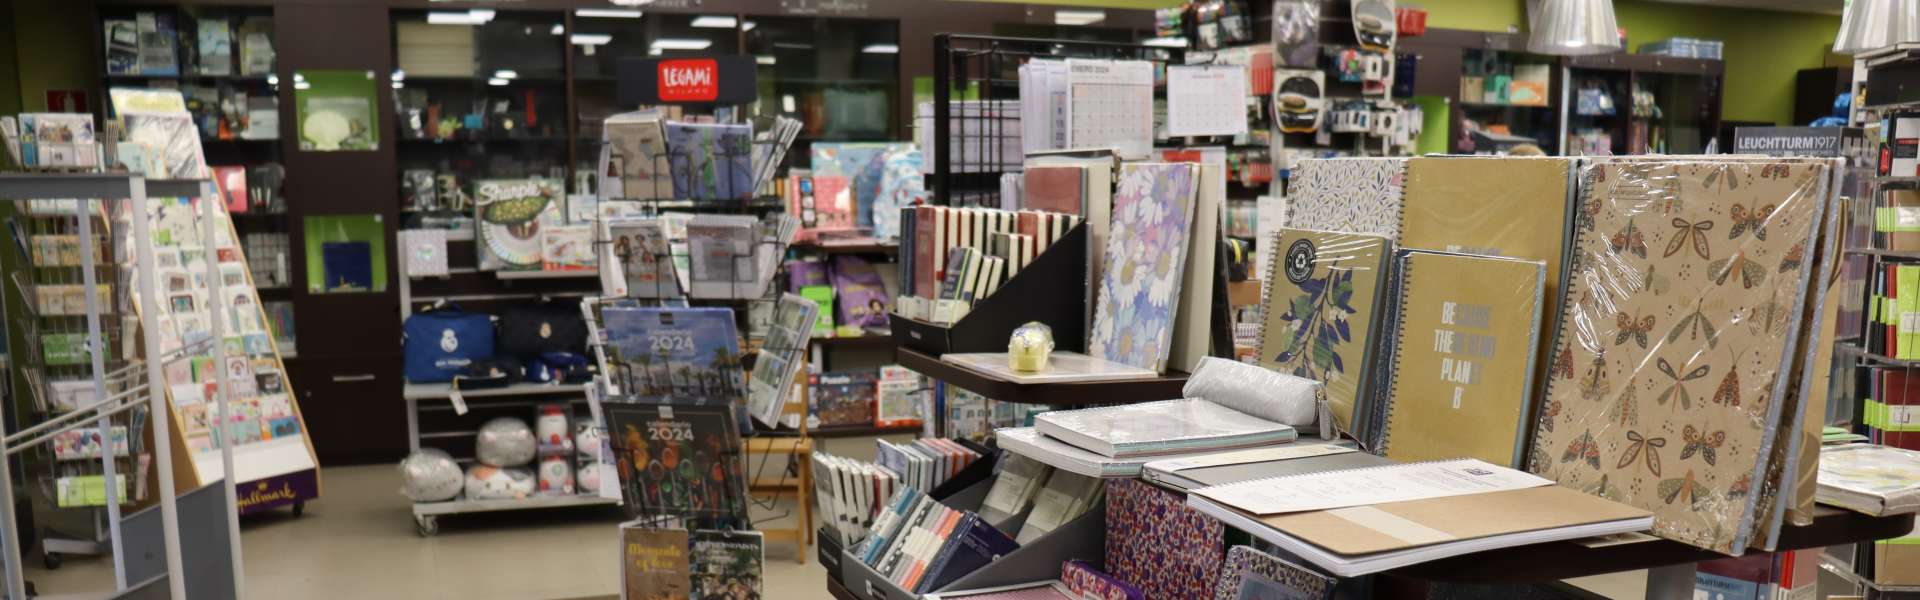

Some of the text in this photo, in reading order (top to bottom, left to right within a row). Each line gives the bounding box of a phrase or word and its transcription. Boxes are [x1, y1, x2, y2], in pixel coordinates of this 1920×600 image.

[1738, 136, 1837, 149] LEUCHTTURM1917
[477, 182, 542, 206] Sharpie
[648, 335, 695, 352] 2024
[1453, 386, 1463, 409] B
[648, 427, 694, 441] 2024
